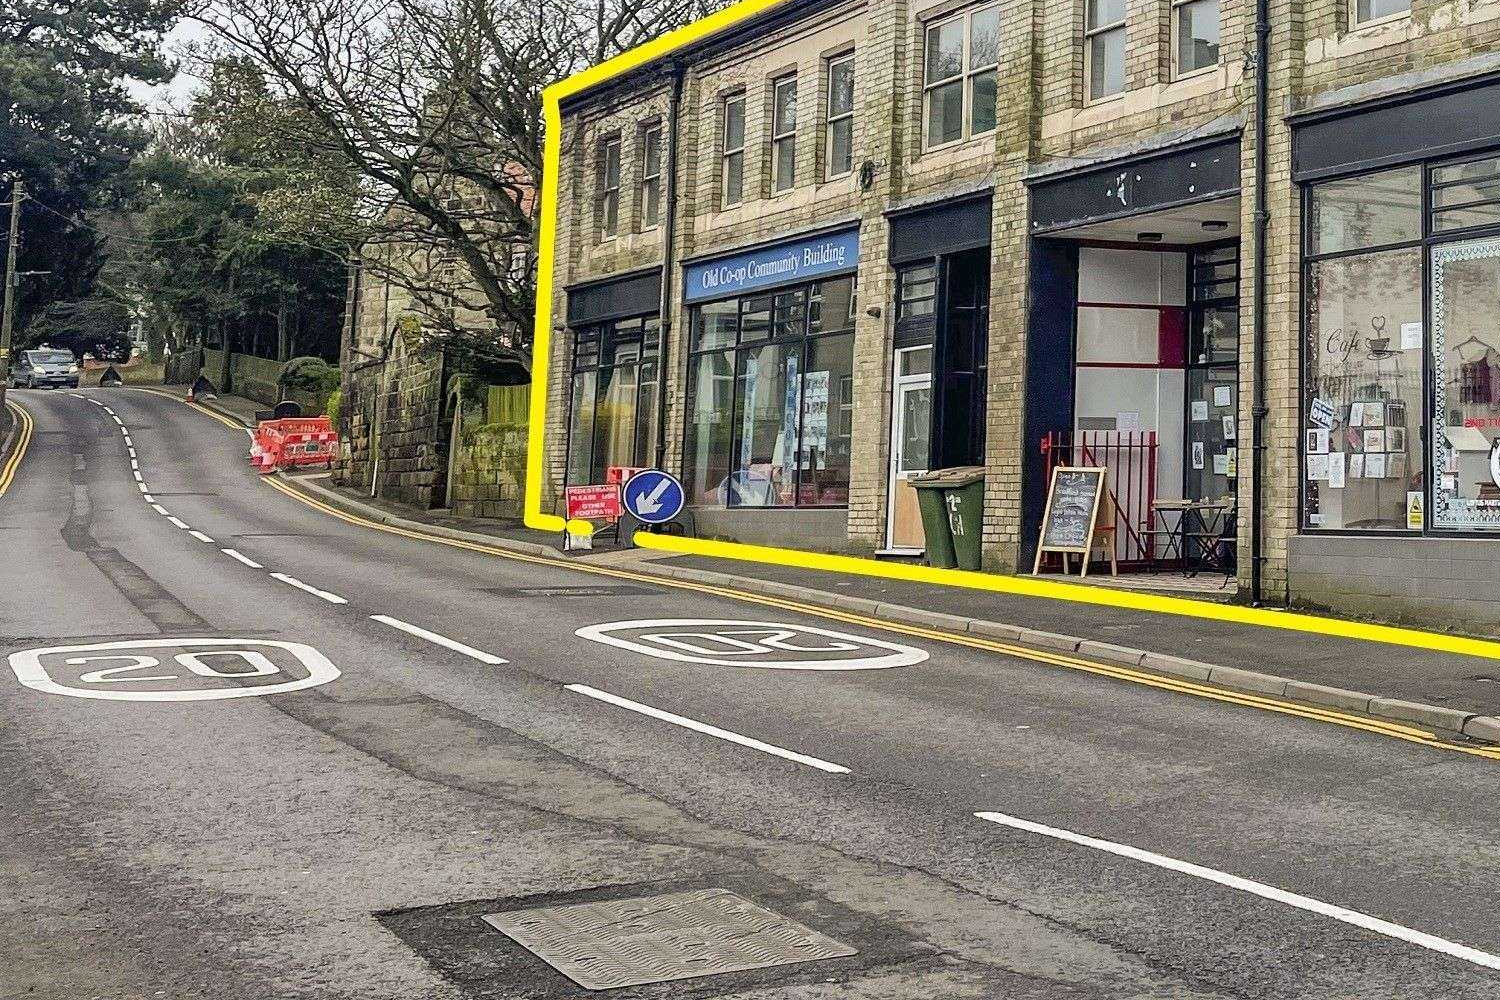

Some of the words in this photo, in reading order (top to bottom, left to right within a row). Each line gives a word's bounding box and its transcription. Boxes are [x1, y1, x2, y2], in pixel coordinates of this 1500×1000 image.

[702, 266, 718, 289] Old
[719, 263, 746, 285] Co-op
[747, 251, 800, 279] Community
[803, 242, 845, 267] Building
[65, 649, 281, 683] 20
